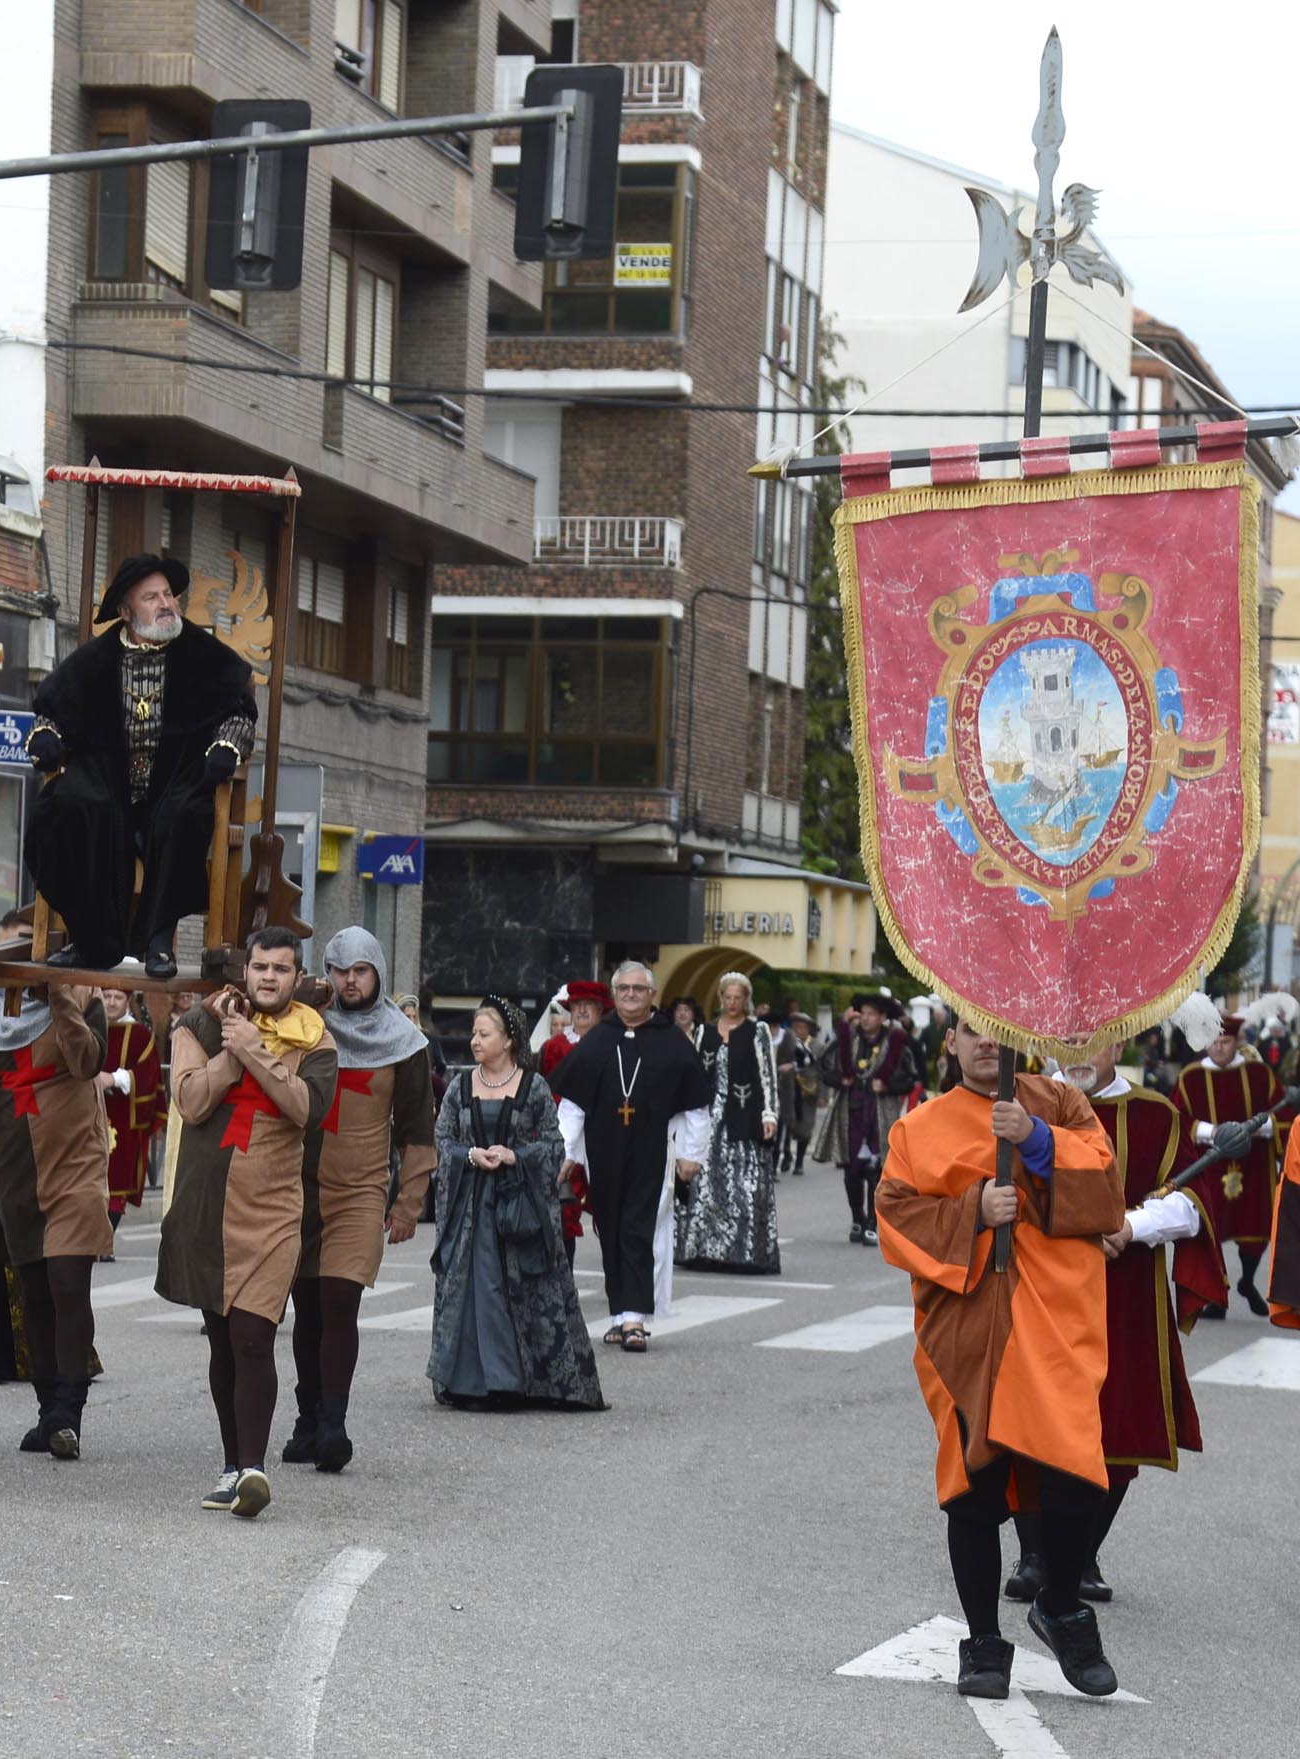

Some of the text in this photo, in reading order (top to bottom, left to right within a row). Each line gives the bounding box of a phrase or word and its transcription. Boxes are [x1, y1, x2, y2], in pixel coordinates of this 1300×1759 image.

[619, 256, 672, 268] VENDE
[1038, 616, 1123, 664] ARMAS
[379, 854, 416, 873] AXA
